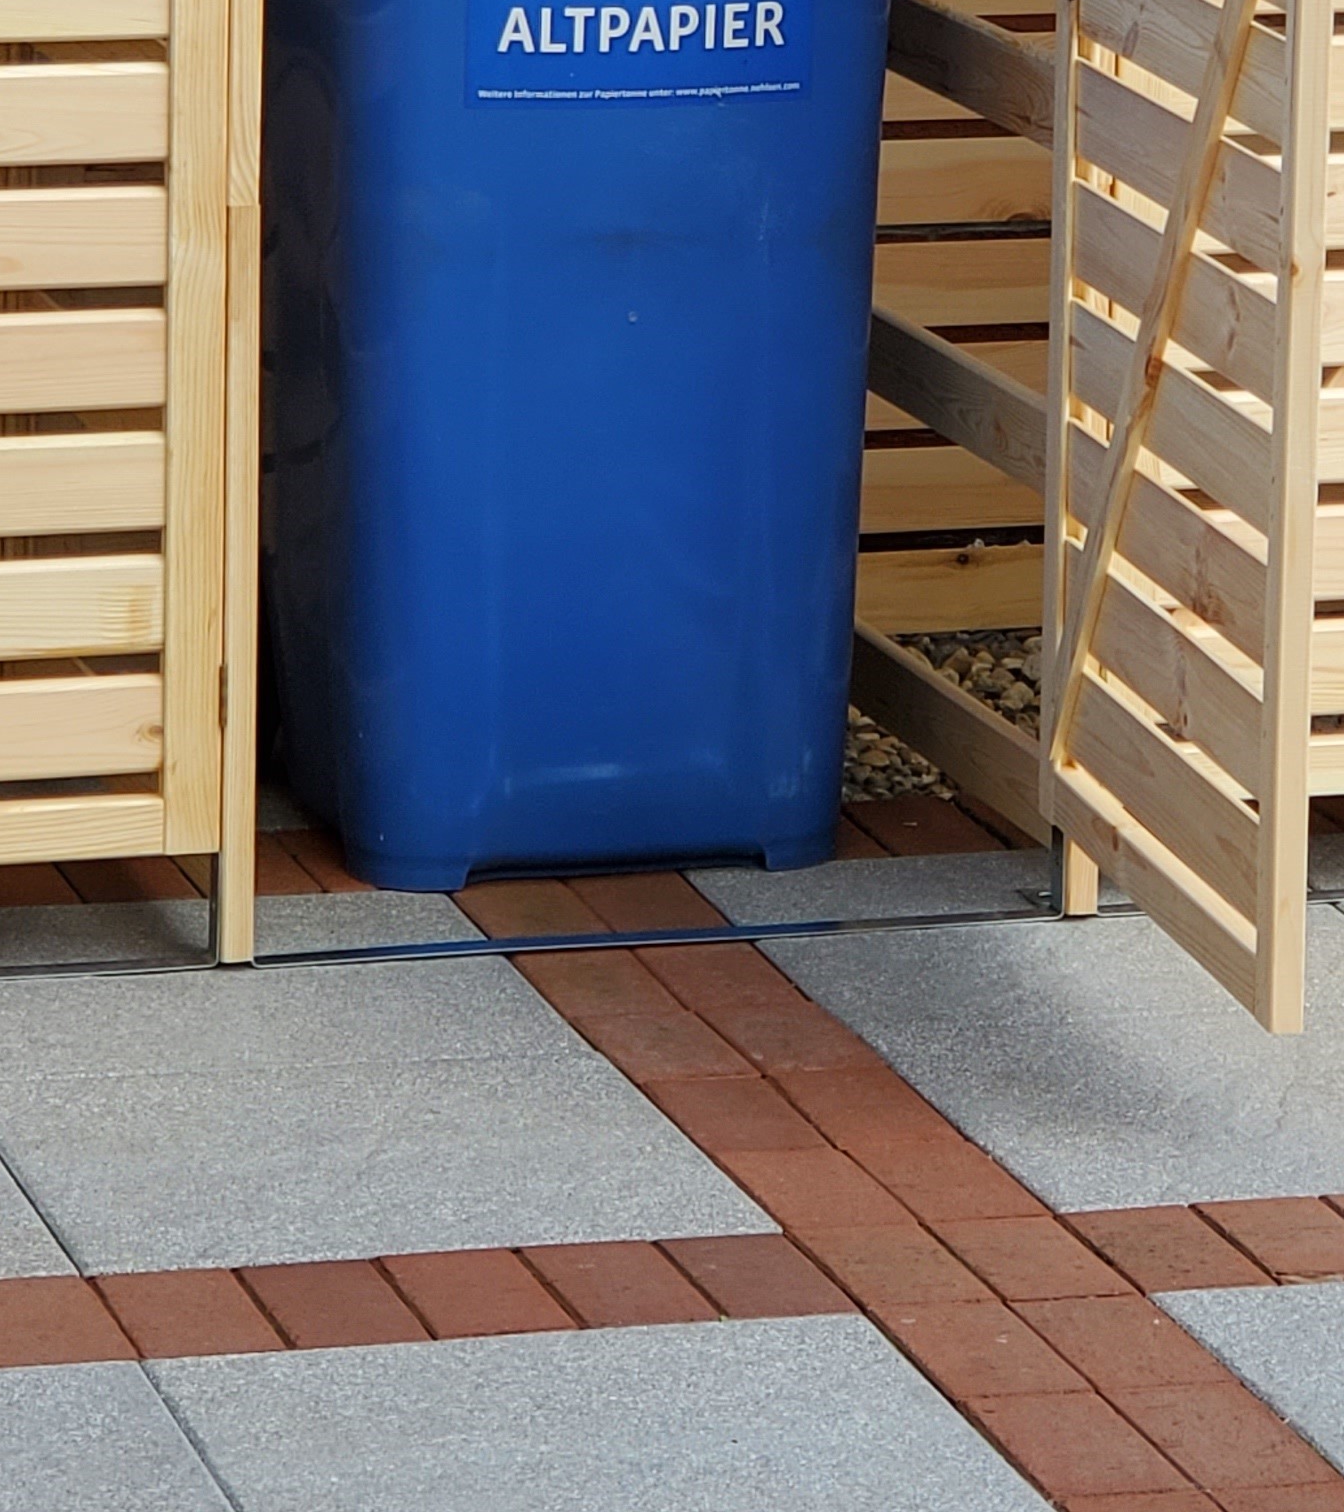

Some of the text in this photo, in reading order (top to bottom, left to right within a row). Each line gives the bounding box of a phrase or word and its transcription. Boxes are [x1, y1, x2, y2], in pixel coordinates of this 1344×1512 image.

[497, 1, 785, 54] ALTPAPIER
[477, 89, 513, 99] Weitere
[513, 89, 578, 99] Informationen
[578, 90, 594, 99] zur
